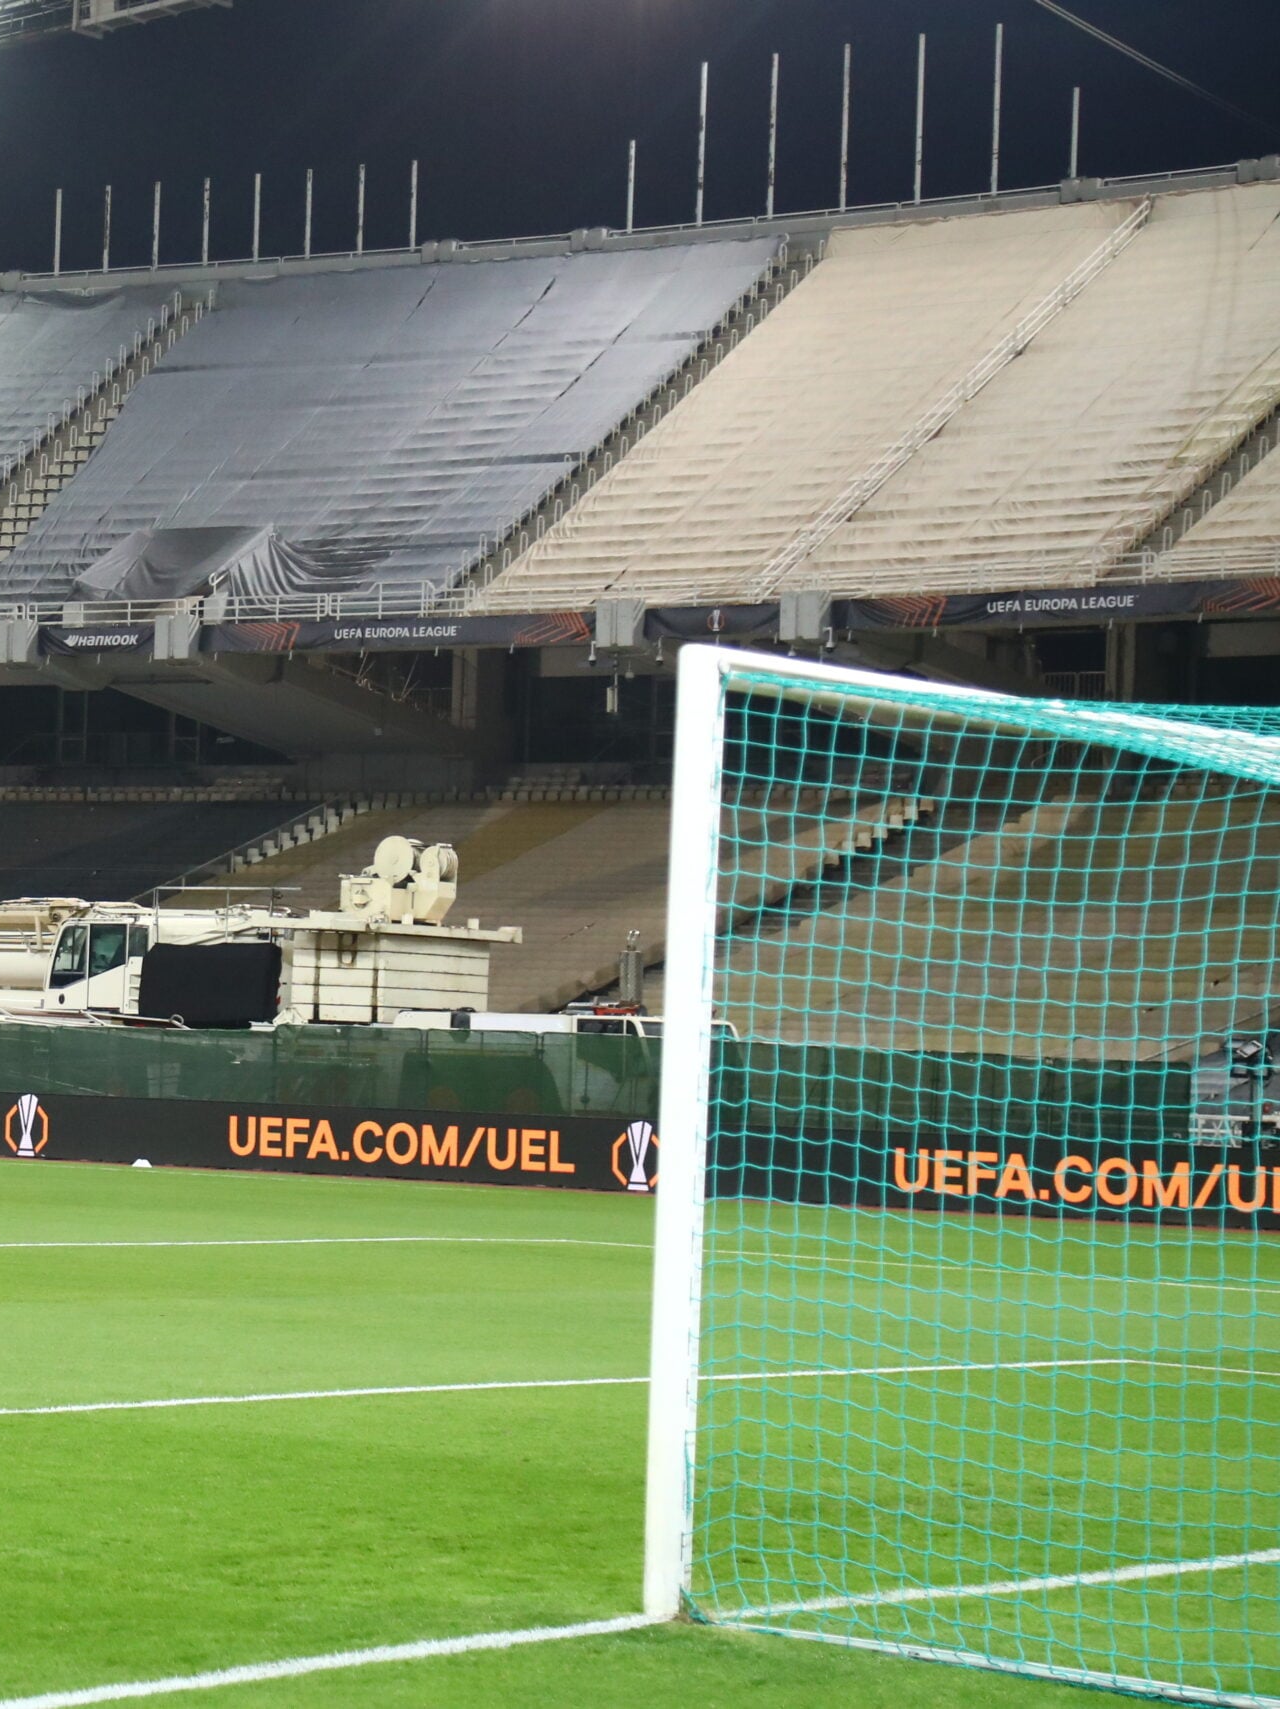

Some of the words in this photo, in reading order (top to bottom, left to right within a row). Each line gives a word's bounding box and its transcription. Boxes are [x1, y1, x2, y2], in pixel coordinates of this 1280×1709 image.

[986, 600, 1022, 613] UEFA
[1024, 597, 1079, 611] EUROPA
[334, 627, 362, 640] UEFA
[364, 627, 410, 639] EUROPA
[228, 1114, 576, 1174] UEFA.COM/UEL
